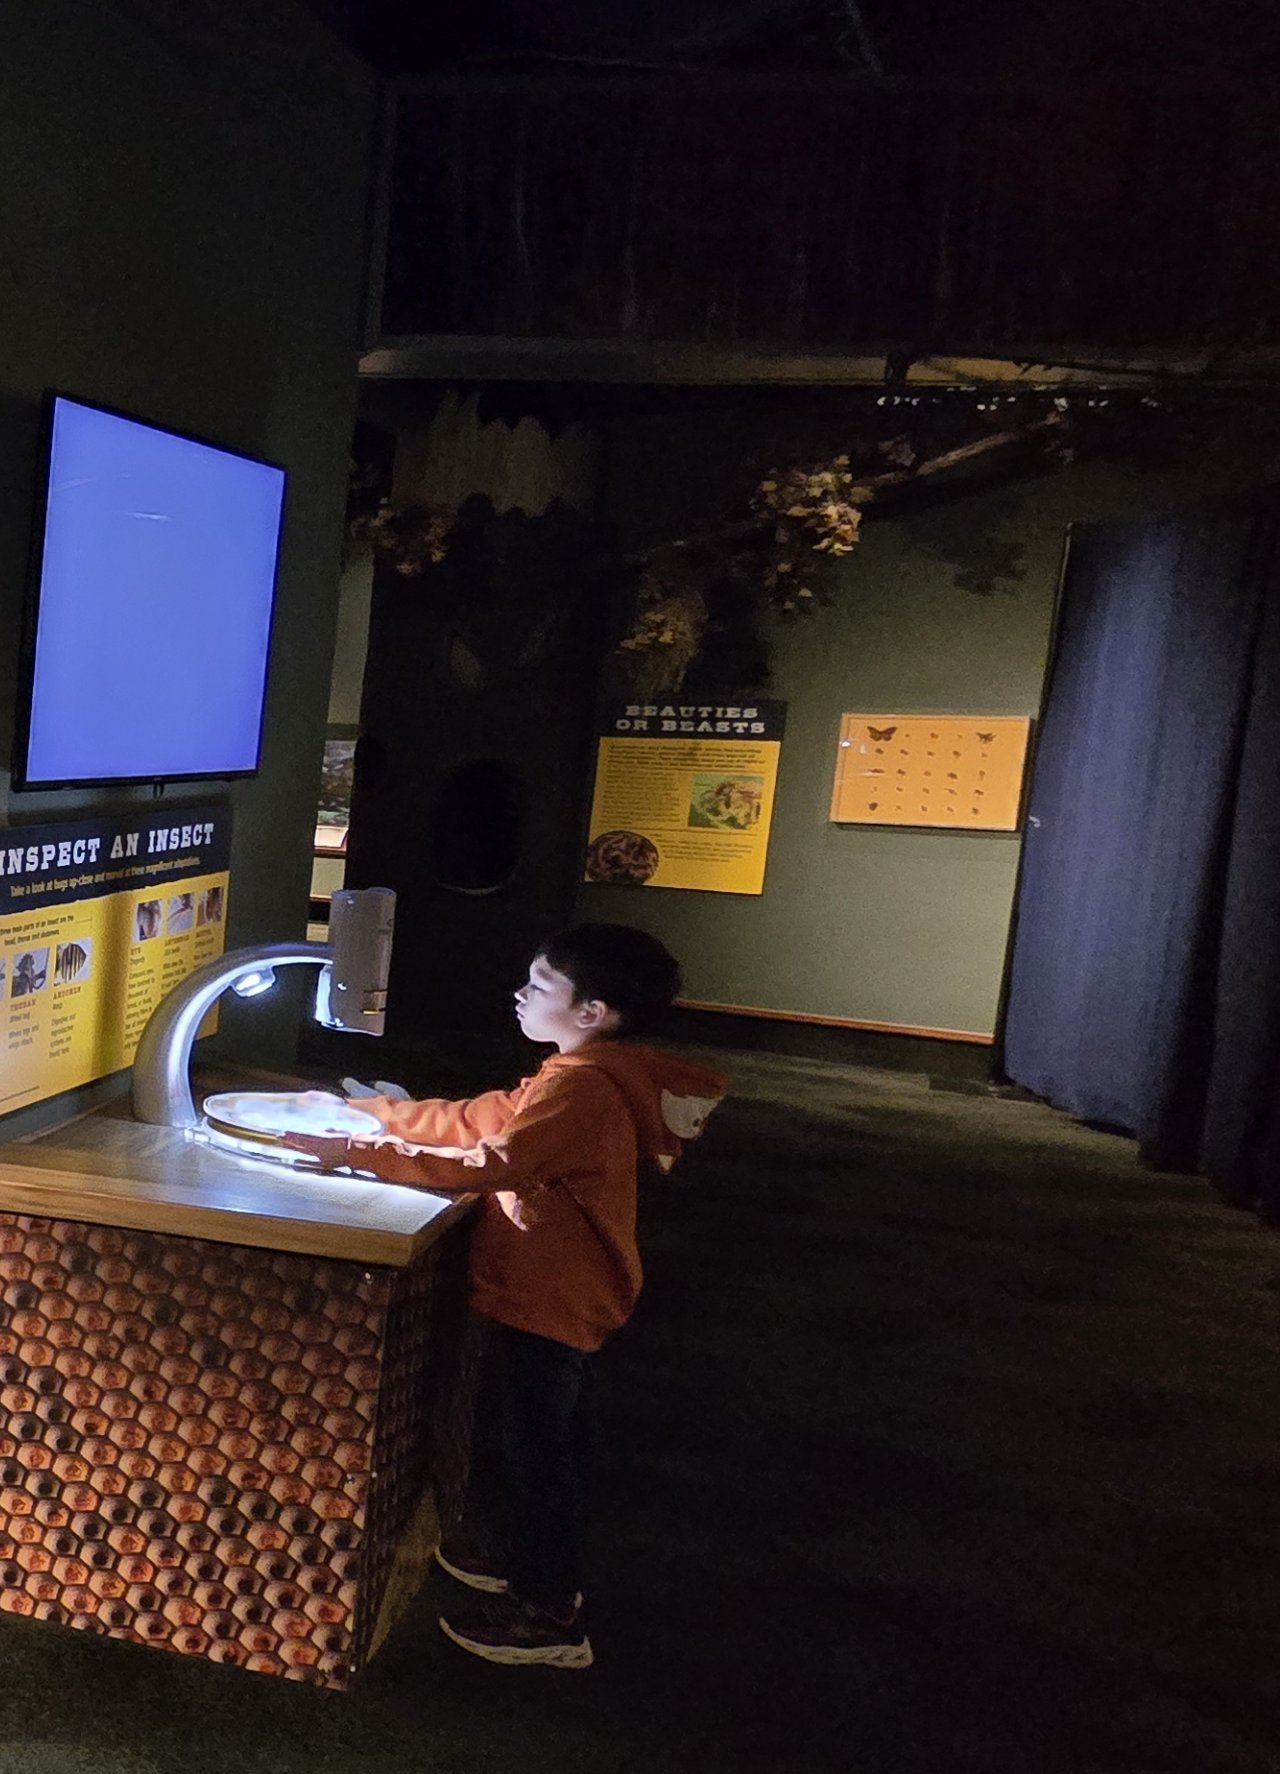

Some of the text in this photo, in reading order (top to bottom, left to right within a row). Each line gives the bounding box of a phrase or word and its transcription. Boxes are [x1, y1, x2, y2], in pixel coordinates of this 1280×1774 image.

[625, 705, 759, 719] BEAUTIES
[616, 719, 765, 733] OR BEASTS
[110, 832, 140, 859] AN
[147, 823, 214, 853] INSECT
